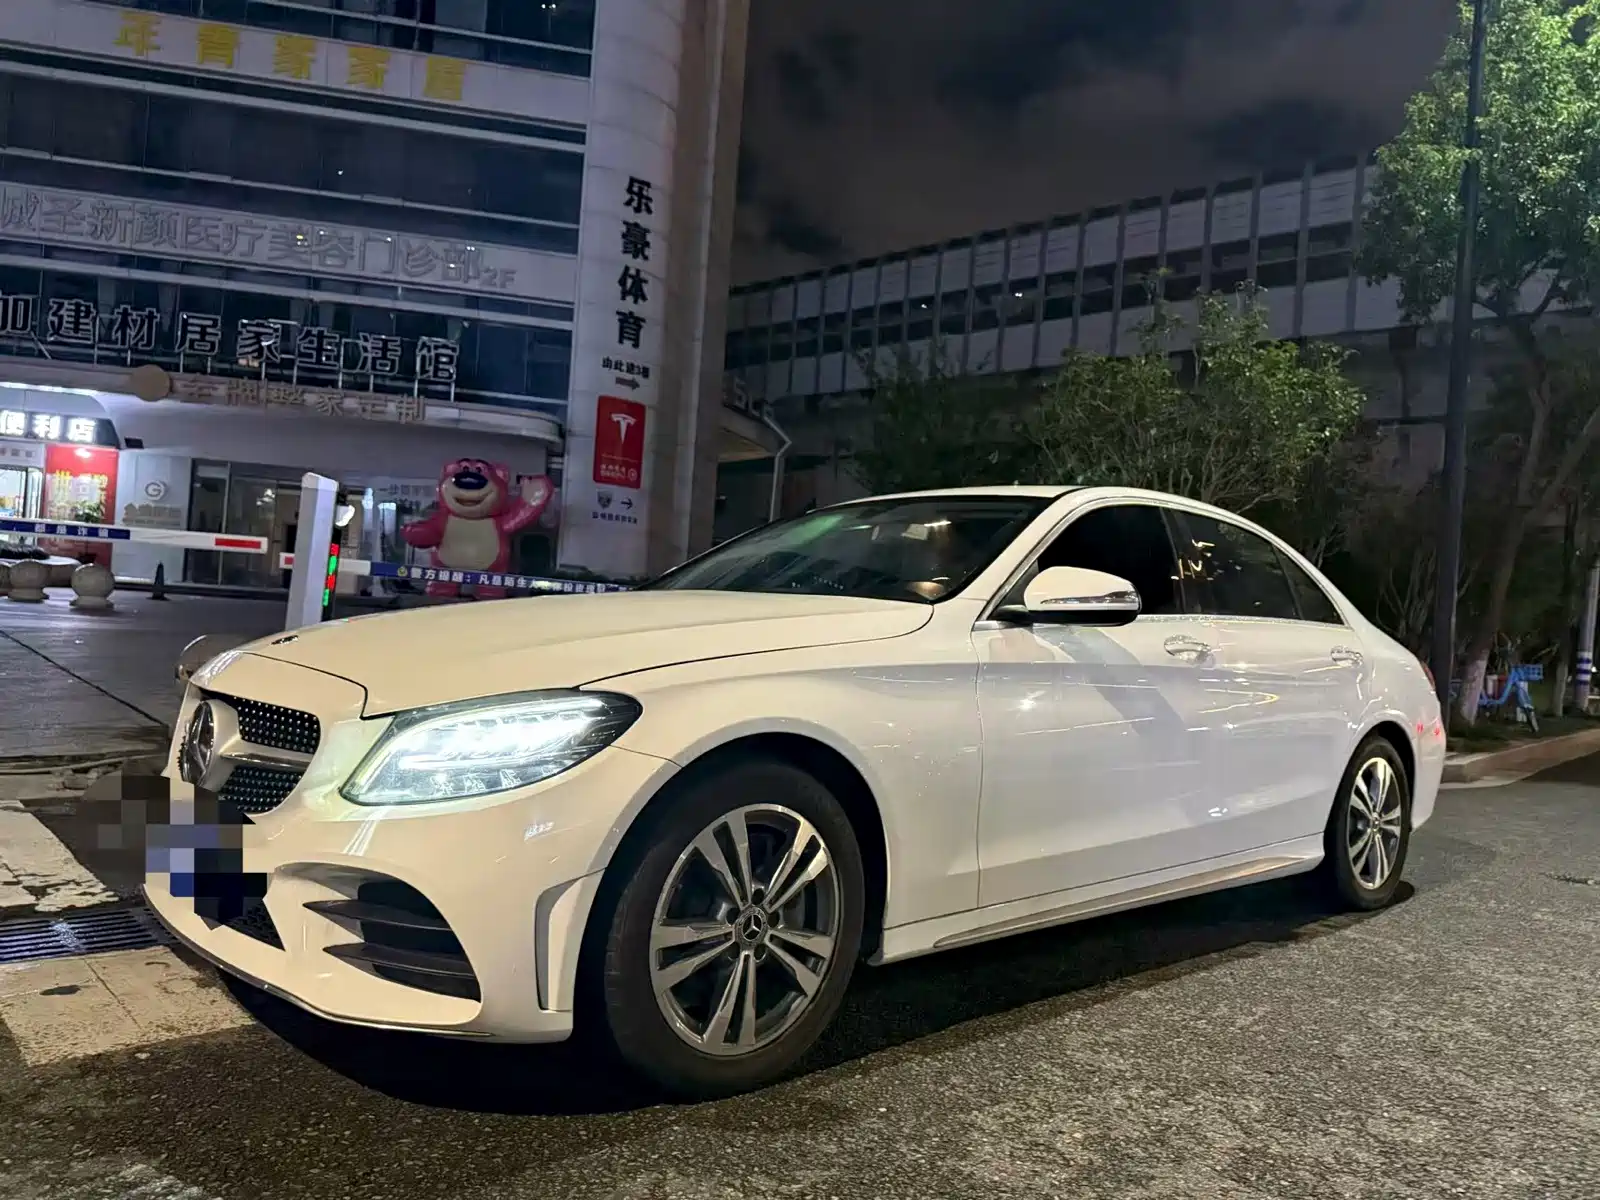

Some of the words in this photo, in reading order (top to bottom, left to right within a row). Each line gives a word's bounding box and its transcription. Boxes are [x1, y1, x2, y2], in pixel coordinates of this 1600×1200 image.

[615, 175, 653, 349] 乐豪体育
[0, 409, 95, 442] 便利店
